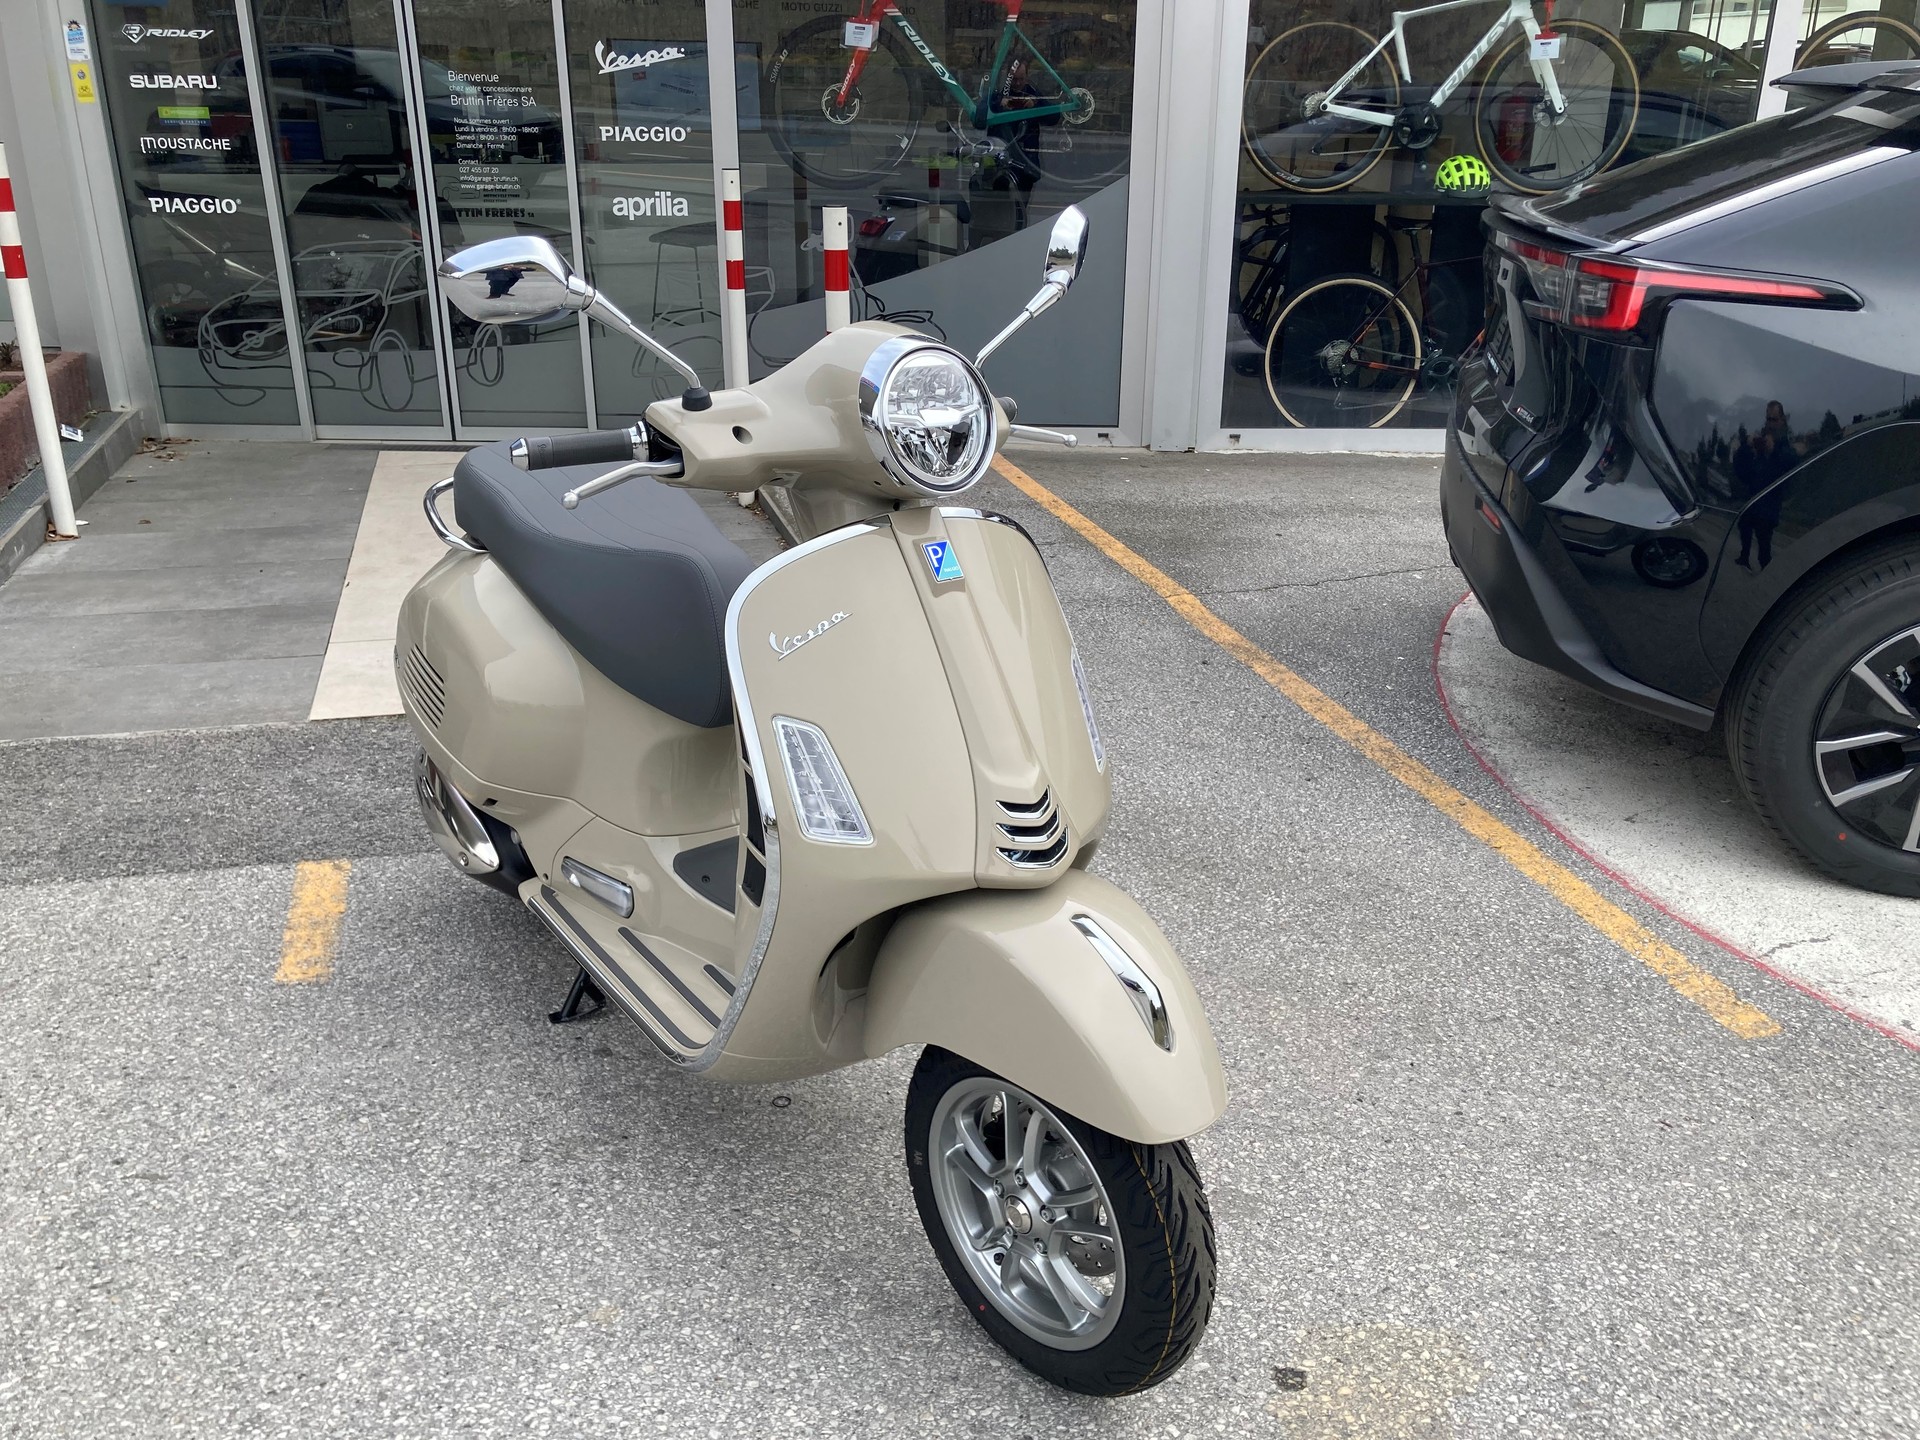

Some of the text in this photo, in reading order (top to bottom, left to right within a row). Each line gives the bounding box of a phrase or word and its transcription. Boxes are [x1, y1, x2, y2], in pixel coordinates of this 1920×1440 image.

[781, 2, 843, 13] MOTO GUZZI
[146, 28, 215, 41] RIDLEY
[594, 40, 685, 75] Vespa
[897, 20, 958, 86] RIDLEY
[129, 74, 218, 90] SUBARU
[447, 70, 499, 83] Bienvenue
[840, 58, 856, 96] RIDLEY
[450, 95, 537, 107] Bruttin Frères SA
[599, 126, 686, 142] PIAGGIO
[149, 197, 239, 214] PIAGGIO
[612, 191, 689, 221] aprilia
[926, 545, 943, 568] P
[769, 610, 854, 661] Vespa
